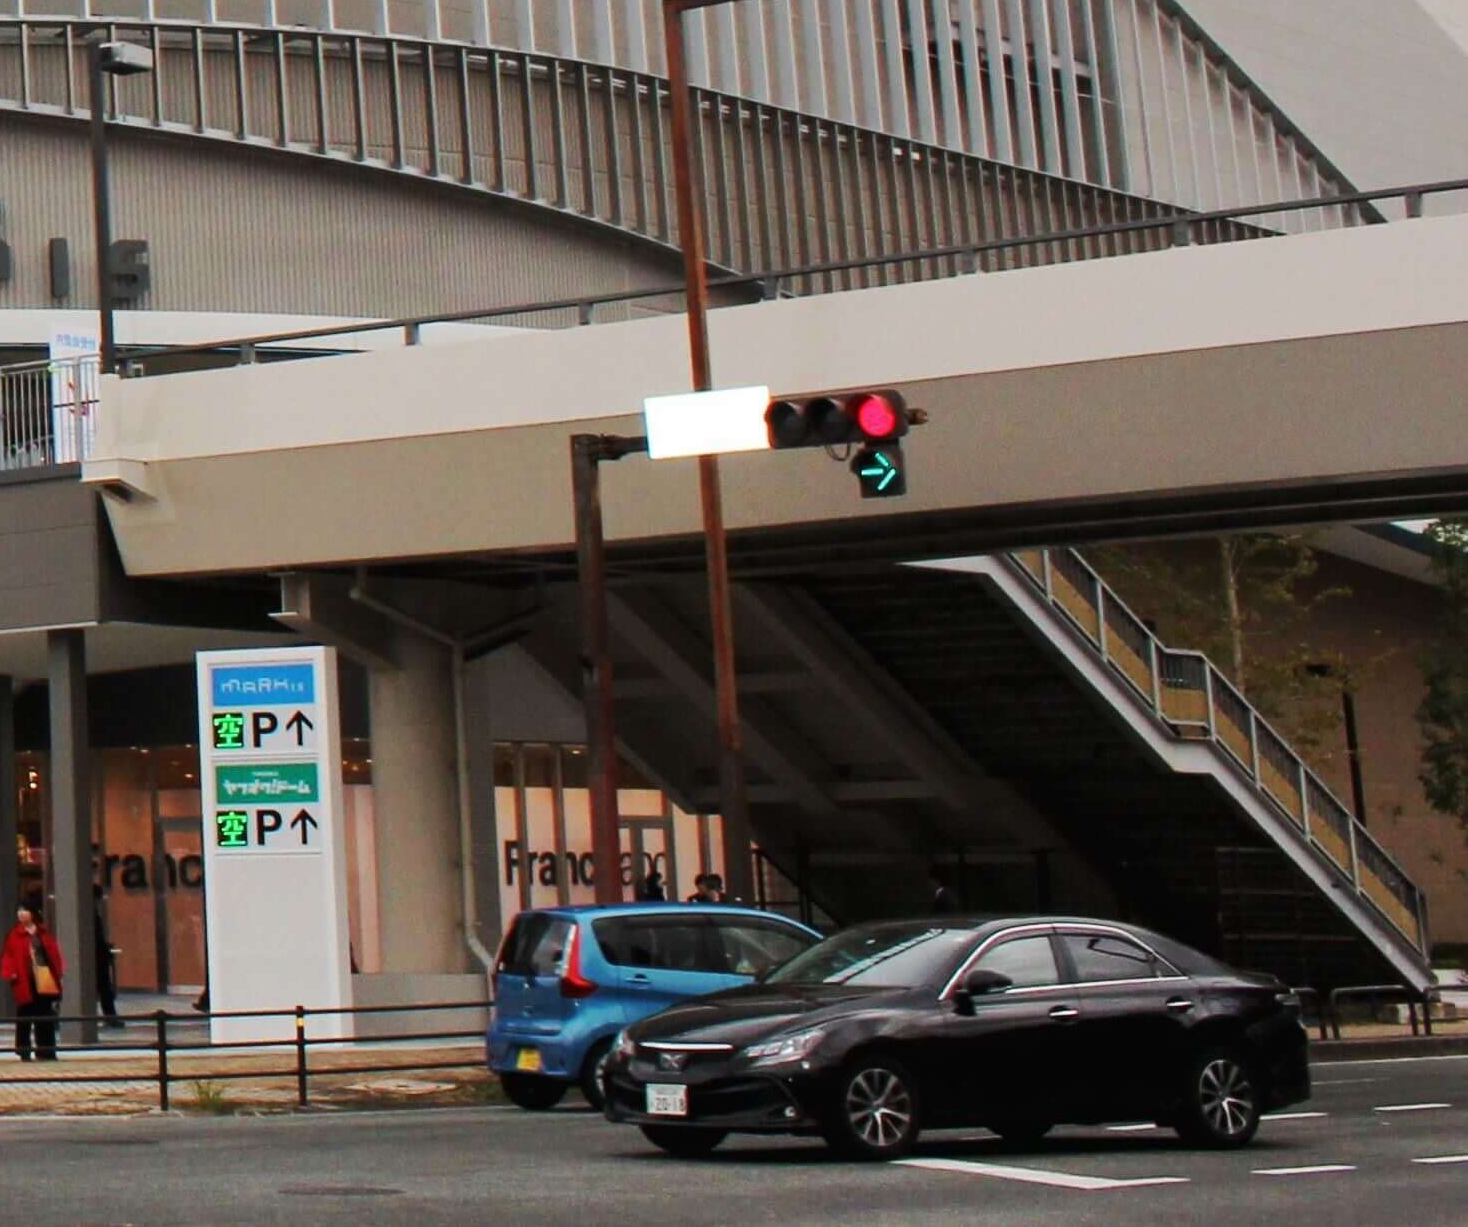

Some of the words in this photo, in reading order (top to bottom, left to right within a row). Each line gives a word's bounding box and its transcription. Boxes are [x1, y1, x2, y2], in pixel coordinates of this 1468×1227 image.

[213, 713, 243, 748] 空
[252, 712, 279, 748] P
[217, 811, 247, 846] 空
[256, 809, 283, 846] P
